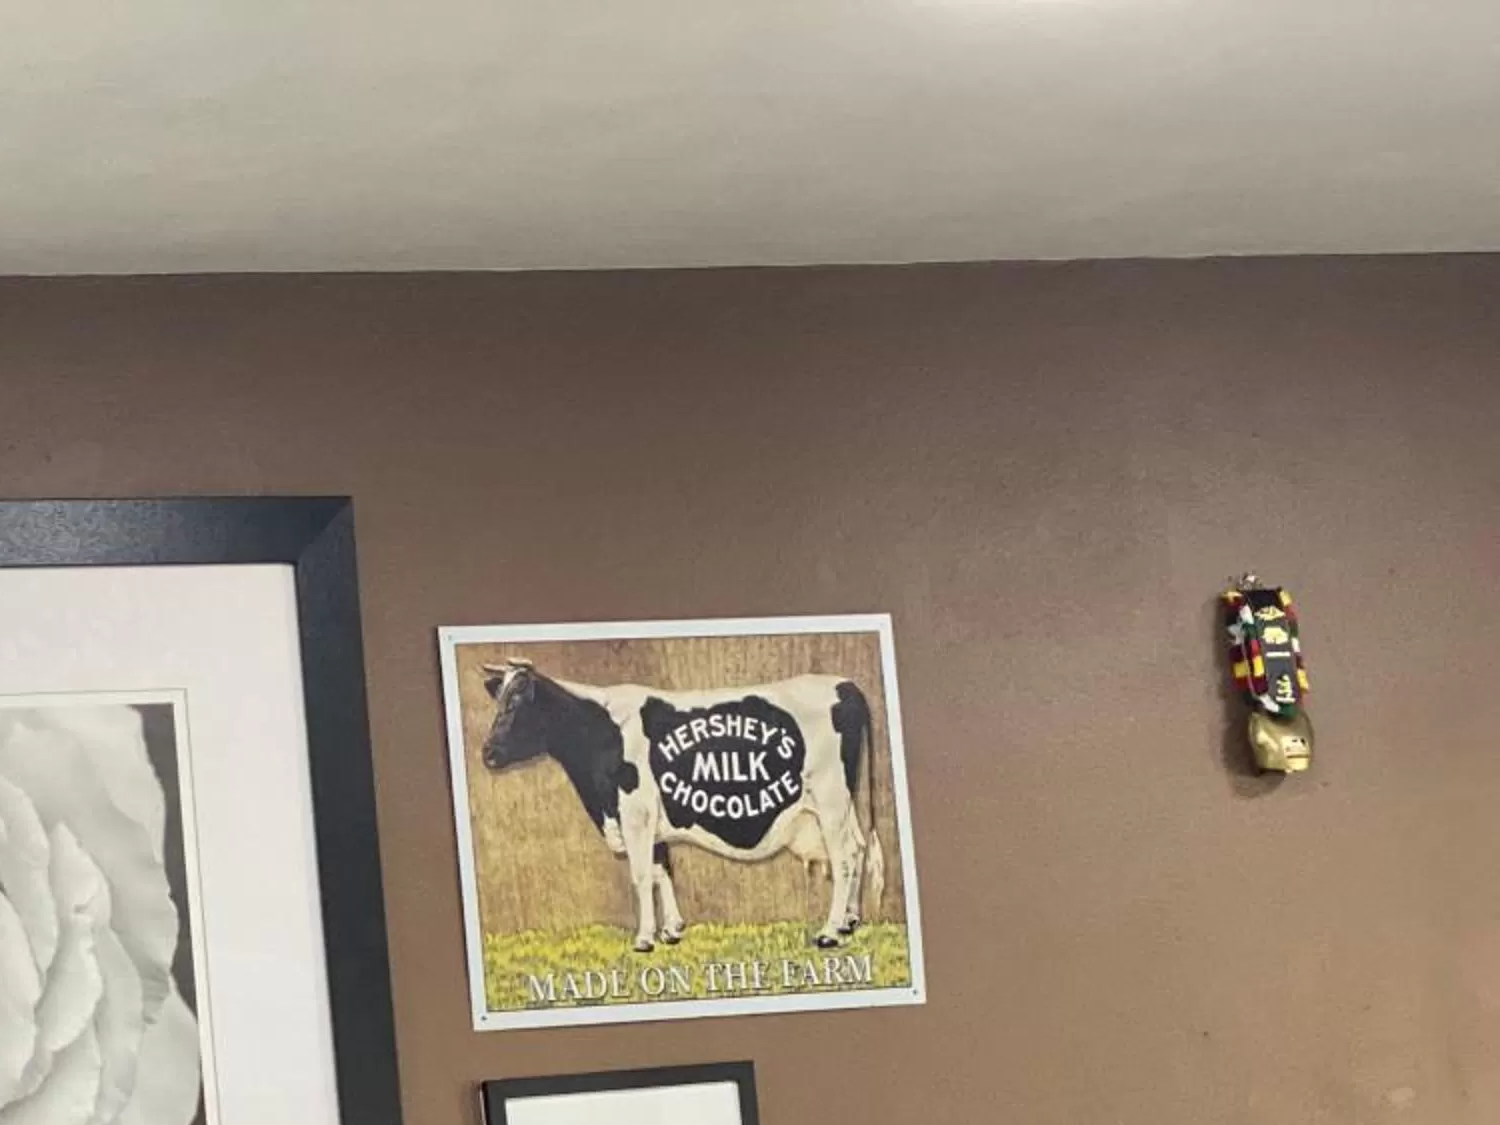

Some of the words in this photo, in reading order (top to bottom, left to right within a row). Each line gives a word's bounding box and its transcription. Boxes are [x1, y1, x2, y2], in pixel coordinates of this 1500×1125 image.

[657, 714, 796, 762] HERSHEY'S
[692, 751, 770, 782] MILK
[660, 770, 799, 819] CHOCOLATE
[527, 968, 630, 1002] MADE
[640, 964, 693, 996] ON
[704, 958, 772, 993] THE
[781, 954, 874, 987] FARM
